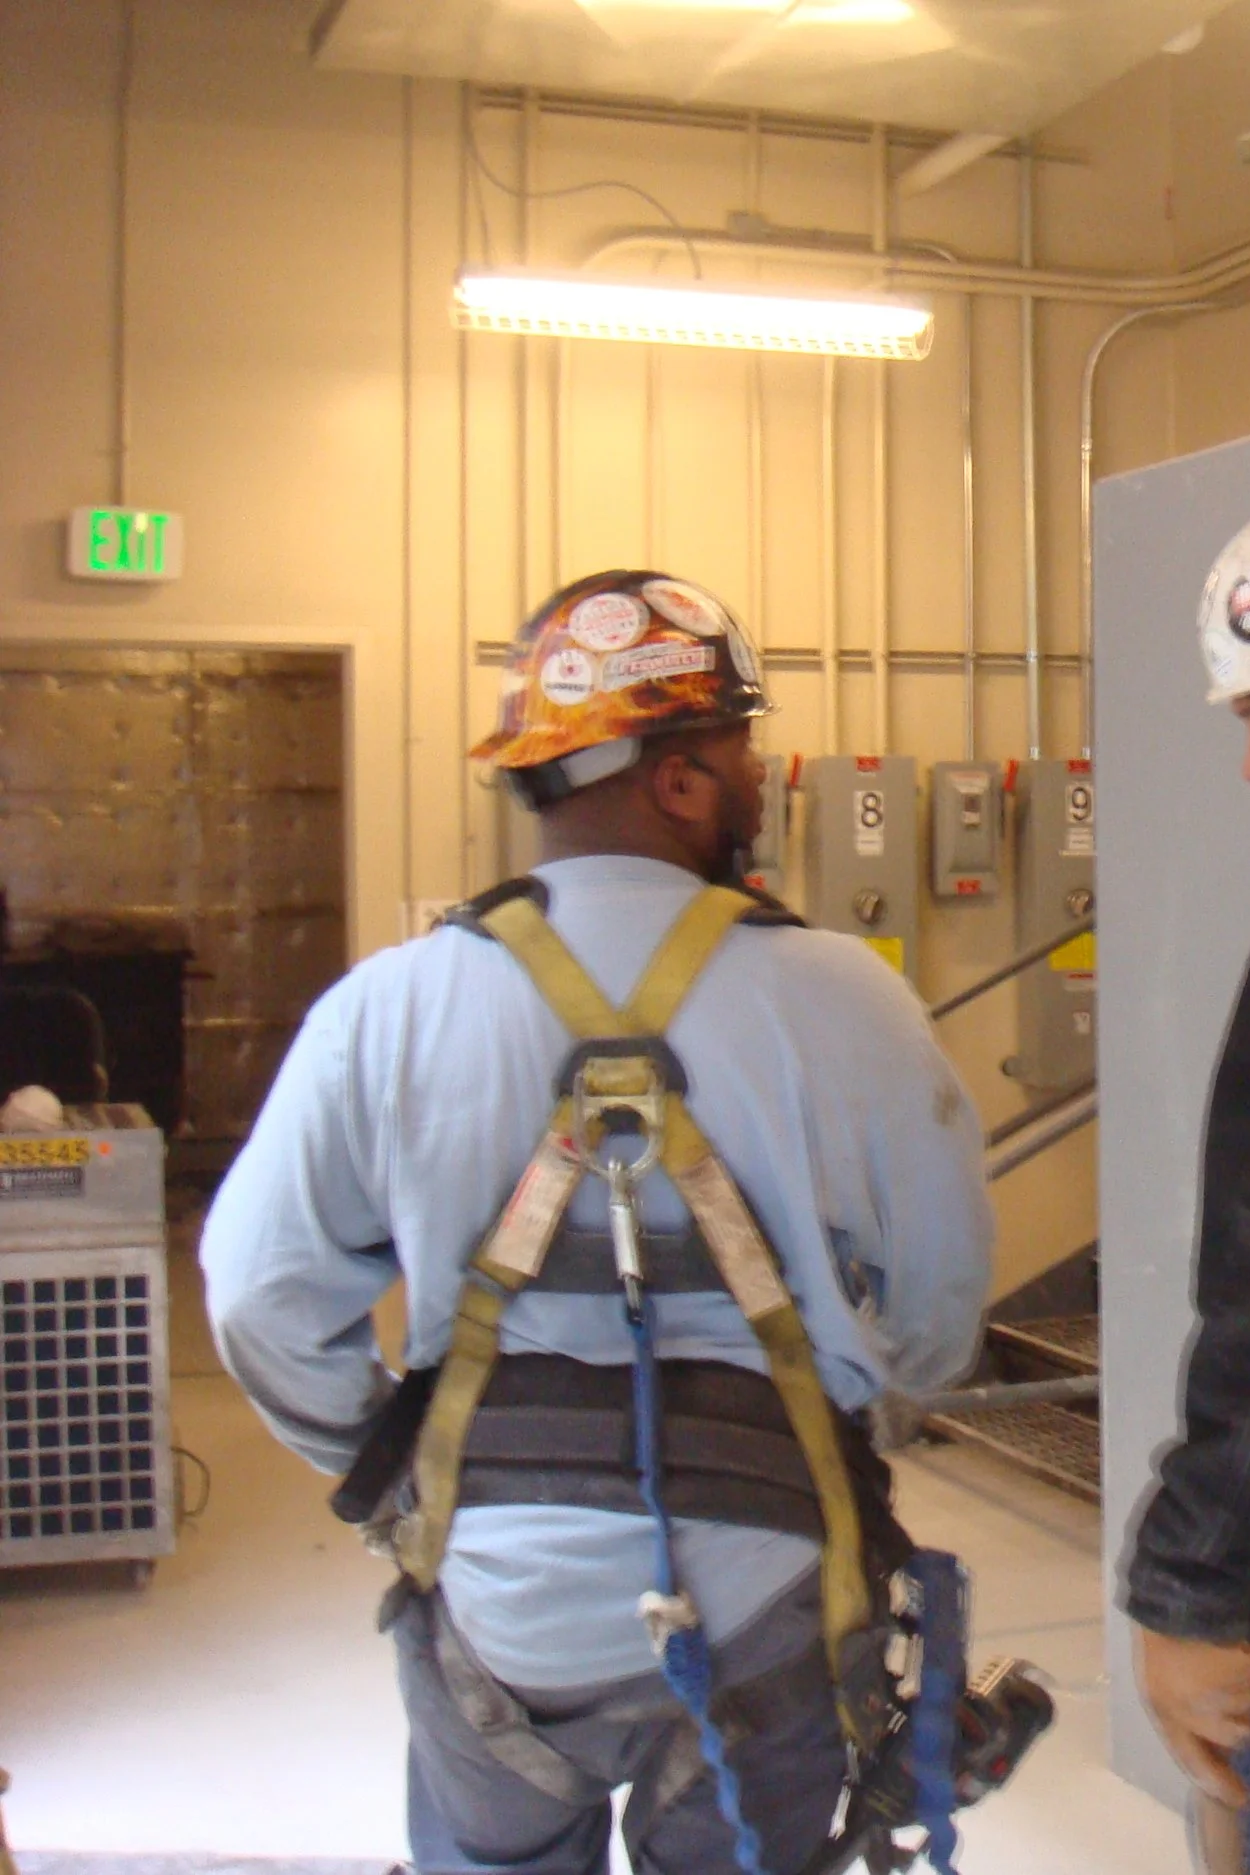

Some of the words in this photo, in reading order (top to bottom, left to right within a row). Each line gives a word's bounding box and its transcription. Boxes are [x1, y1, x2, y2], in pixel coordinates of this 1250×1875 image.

[90, 511, 168, 573] EXIT
[861, 791, 882, 828] 8
[1071, 786, 1092, 821] 9
